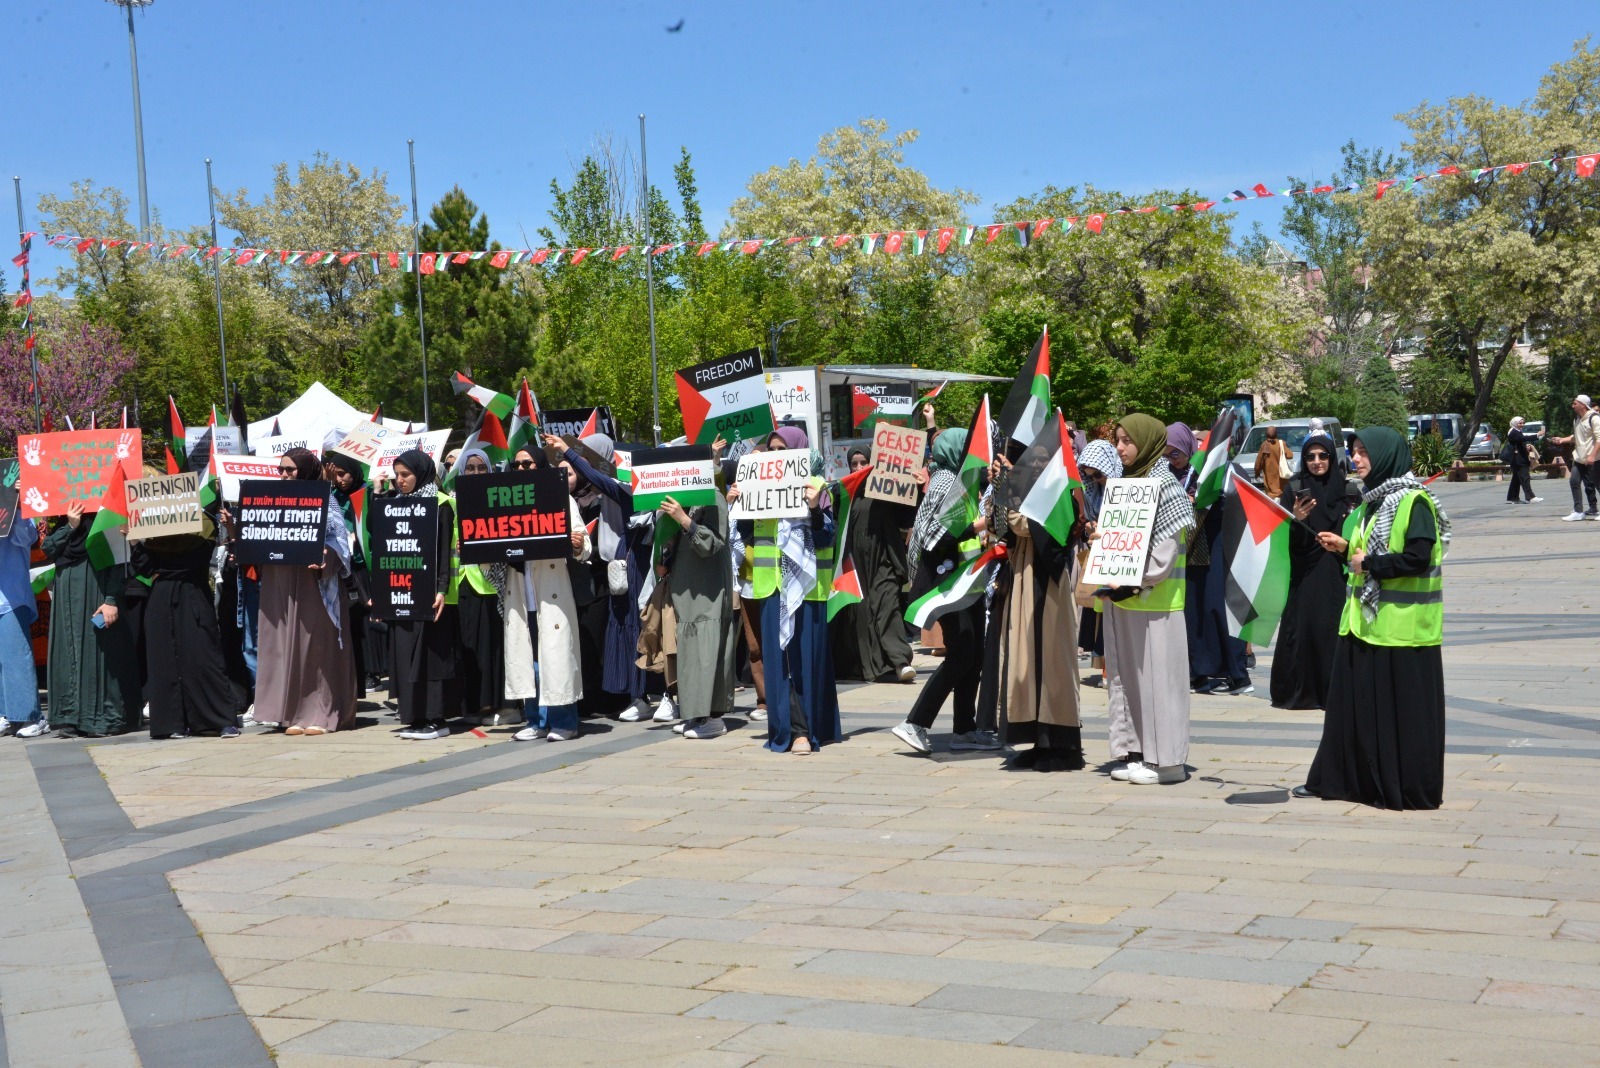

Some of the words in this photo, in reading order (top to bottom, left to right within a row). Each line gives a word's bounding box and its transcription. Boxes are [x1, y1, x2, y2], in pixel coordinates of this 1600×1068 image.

[695, 355, 754, 384] FREEDOM
[722, 391, 740, 405] for
[544, 418, 610, 438] TERROT
[715, 411, 755, 432] GAZA!
[876, 429, 922, 455] CEASE
[226, 463, 280, 476] CEASEFİR
[671, 466, 700, 477] aksada
[875, 452, 914, 476] FIRE
[127, 474, 198, 504] DİRENİŞİN
[640, 478, 680, 490] kurtulacak
[681, 476, 713, 486] El-Aksa
[869, 476, 916, 500] NOW!
[242, 496, 251, 506] BU
[298, 497, 323, 507] KADAR
[486, 483, 536, 508] FREE
[1103, 484, 1159, 505] NEHİRDEN
[127, 502, 200, 528] YANINDAYIZ
[241, 508, 282, 523] BOYKOT
[283, 507, 322, 524] ETMEYİ
[461, 508, 567, 540] PALESTİNE
[1101, 506, 1149, 529] DENİZE
[241, 523, 319, 542] SÜRDÜRECEĞİZ
[395, 521, 413, 535] SU,
[385, 539, 422, 553] YEMEK,
[1101, 530, 1143, 552] ÖZGÜR
[379, 553, 428, 571] ELEKTRİK,
[389, 571, 412, 591] İLAÇ
[391, 591, 415, 605] bitti.
